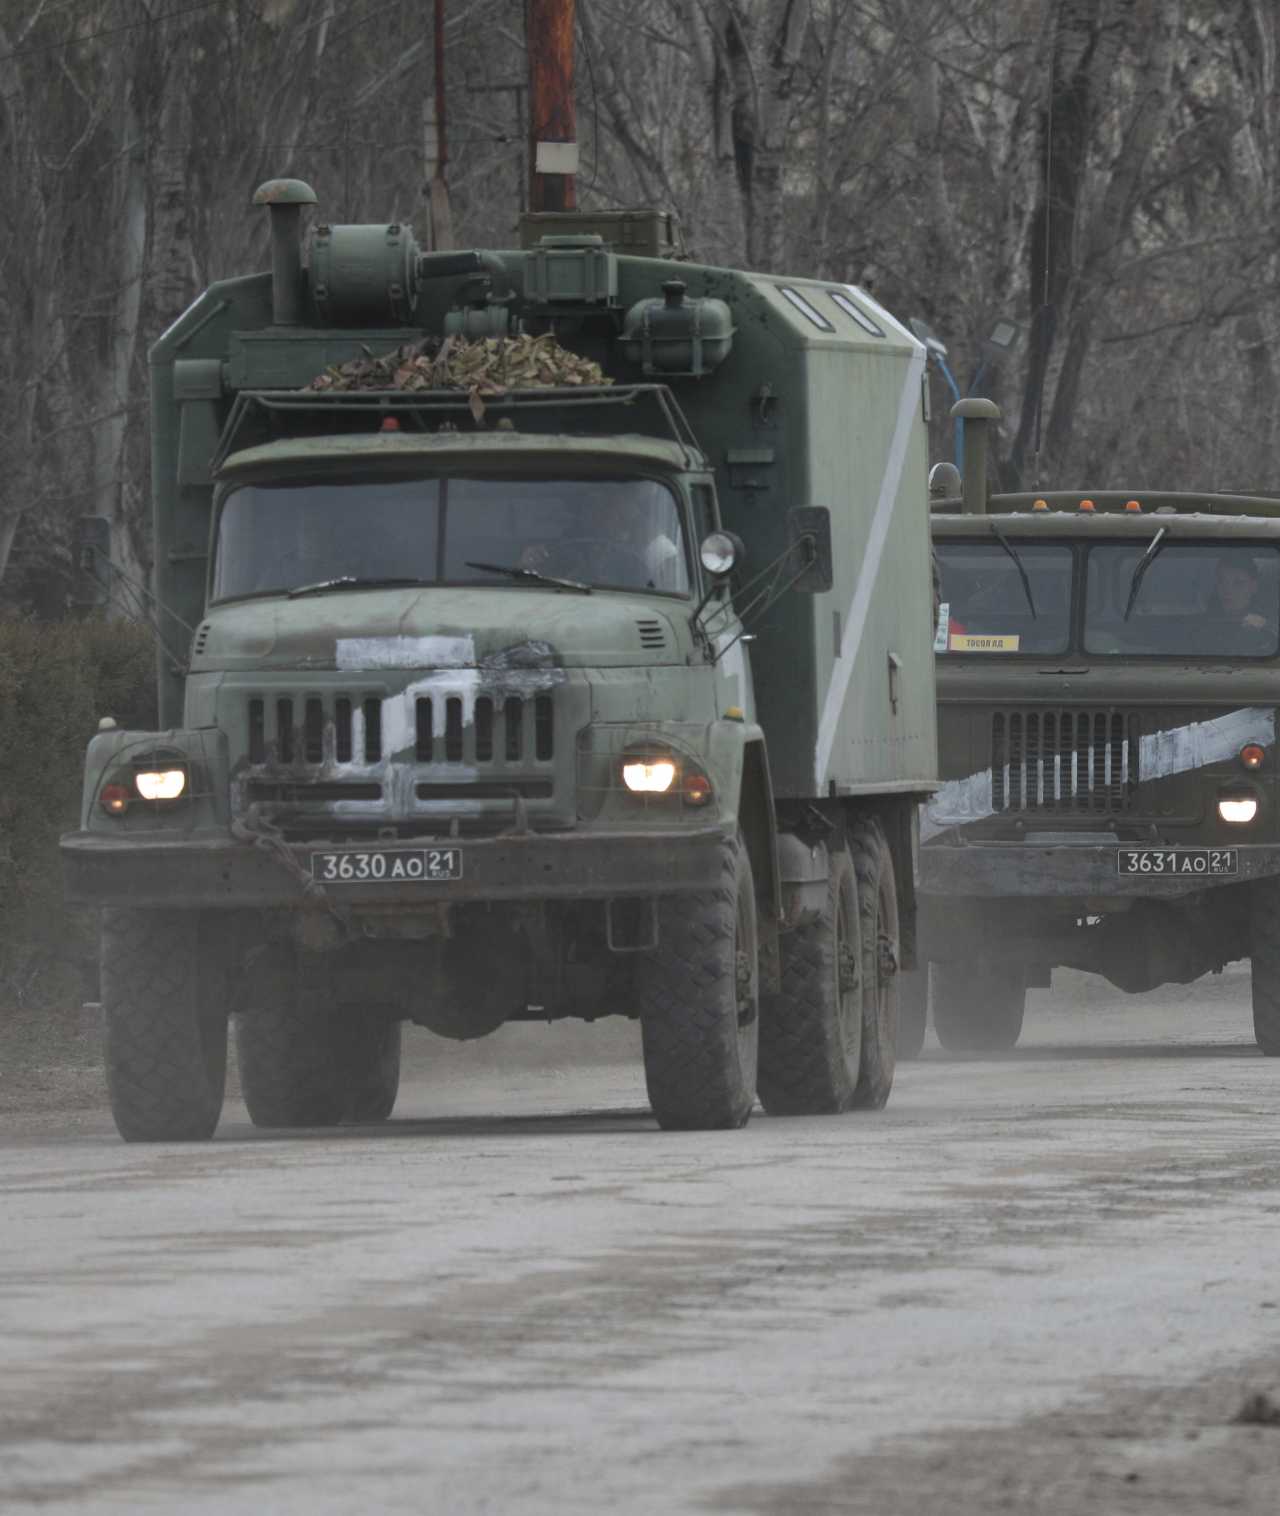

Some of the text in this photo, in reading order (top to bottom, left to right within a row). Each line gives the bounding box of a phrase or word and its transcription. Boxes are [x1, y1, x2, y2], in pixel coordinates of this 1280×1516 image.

[323, 854, 386, 879] 3630
[429, 851, 454, 870] 21
[1127, 853, 1176, 872] 3631
[1211, 852, 1231, 867] 21
